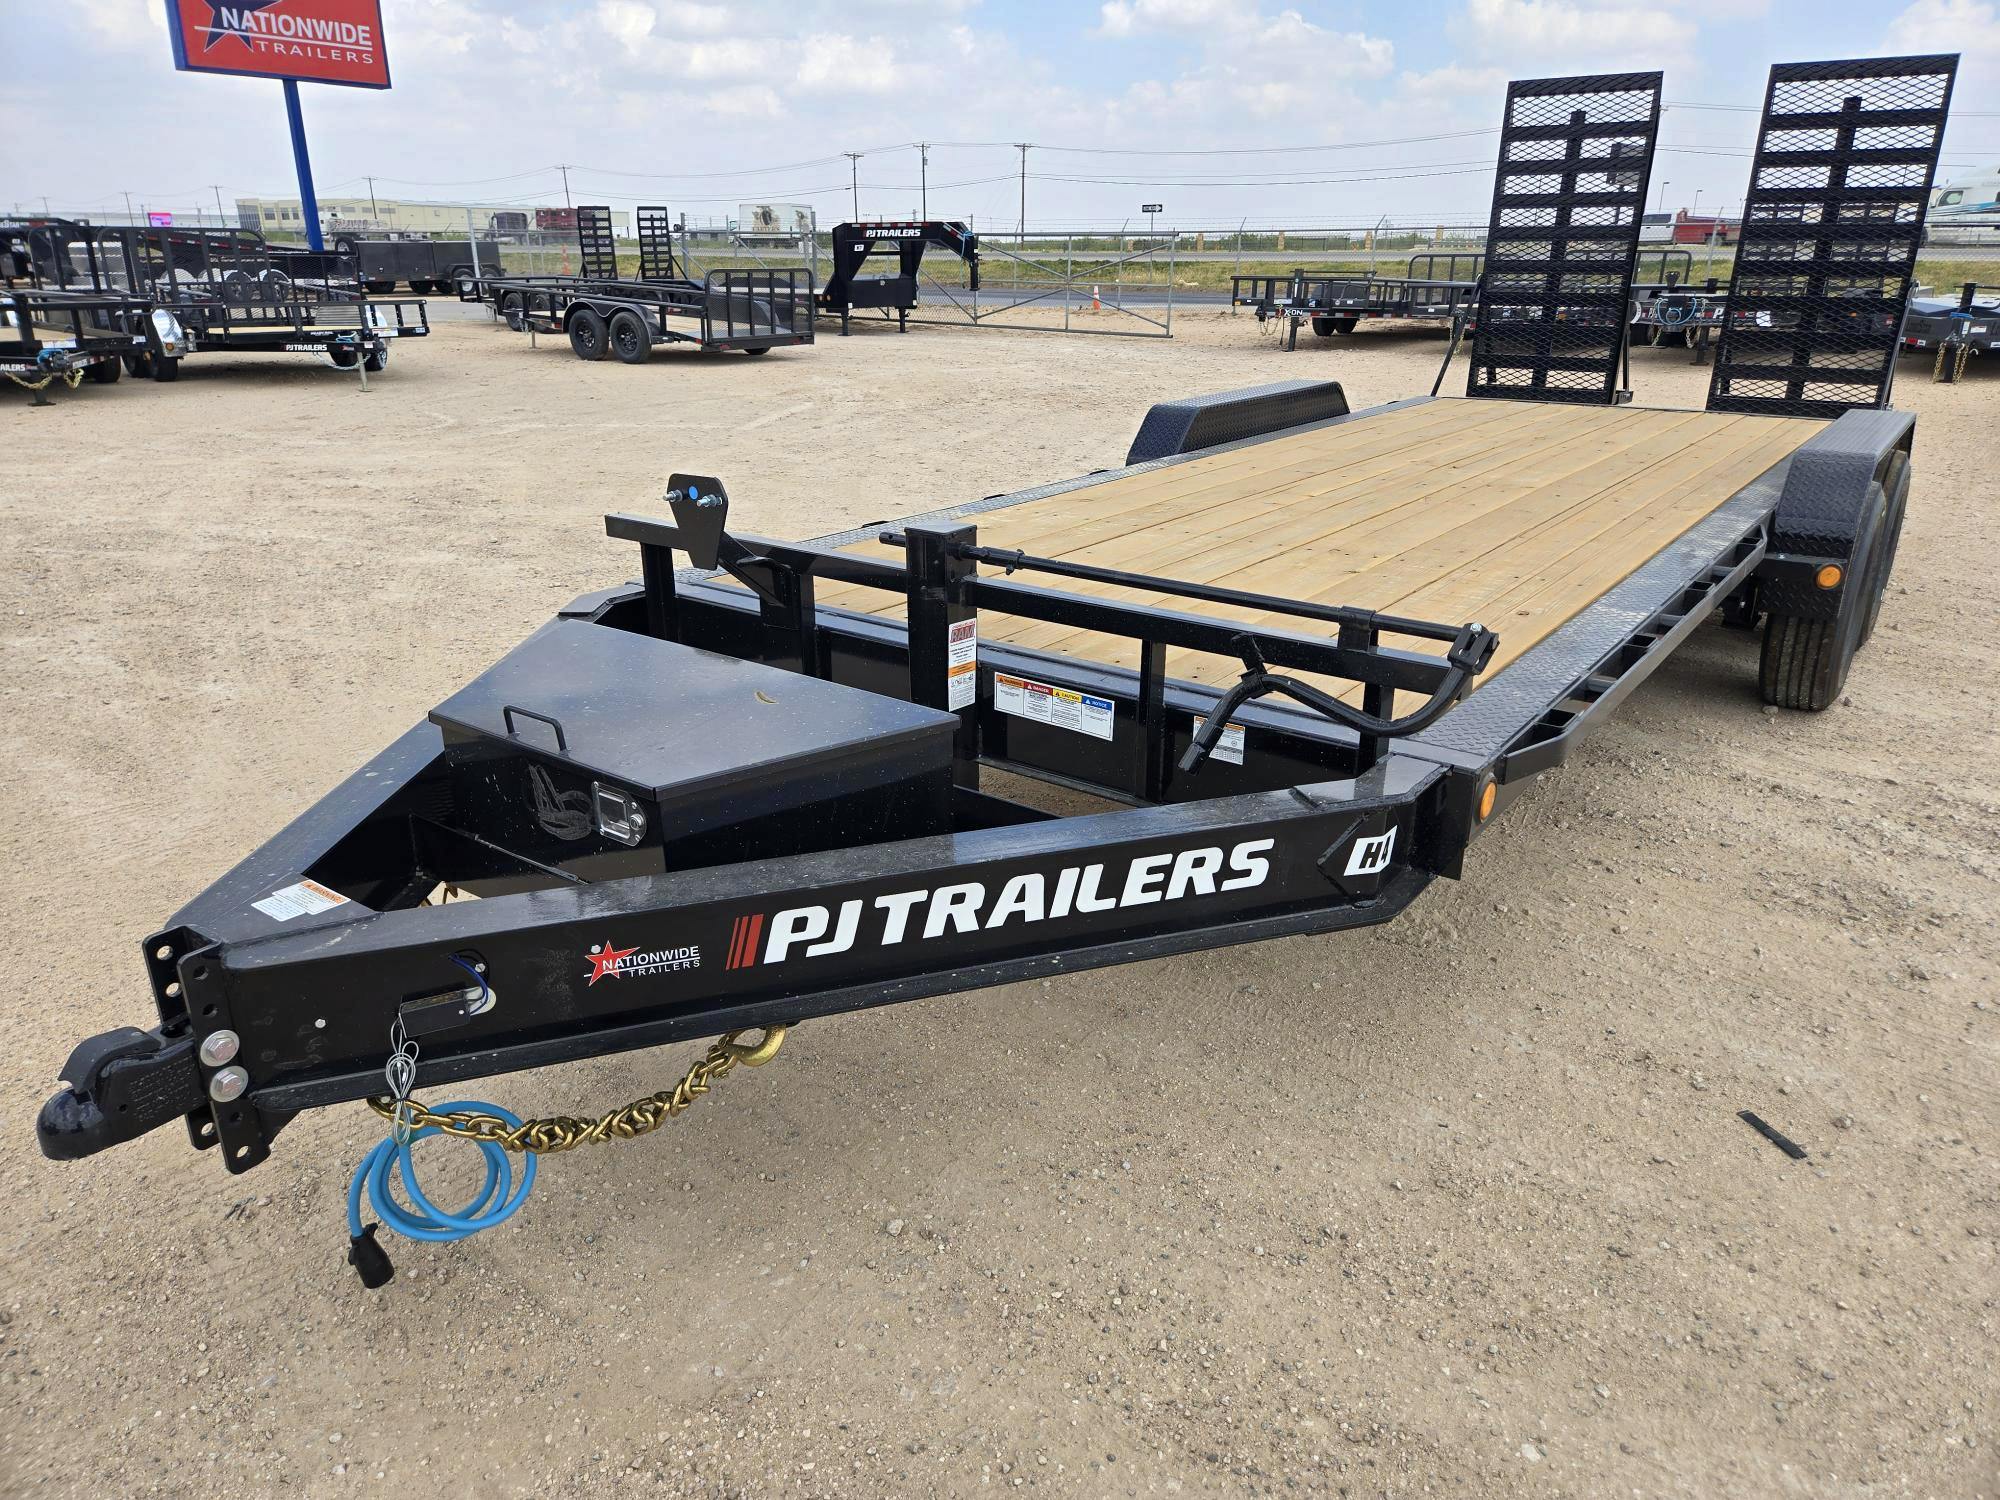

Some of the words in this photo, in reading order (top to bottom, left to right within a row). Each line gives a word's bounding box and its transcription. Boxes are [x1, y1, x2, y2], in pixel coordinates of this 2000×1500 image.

[220, 7, 372, 46] NATIONWIDE
[256, 41, 373, 64] TRAILERS
[866, 229, 876, 237] PJ
[876, 229, 921, 237] TRAILERS
[1032, 685, 1049, 694] DANGER
[1061, 692, 1080, 701] CAUTION
[1091, 700, 1107, 709] NOTICE
[763, 899, 863, 965] PJ
[875, 838, 1275, 946] TRAILERS
[602, 945, 700, 971] NATIONWIDE
[629, 960, 700, 978] TRAILERS
